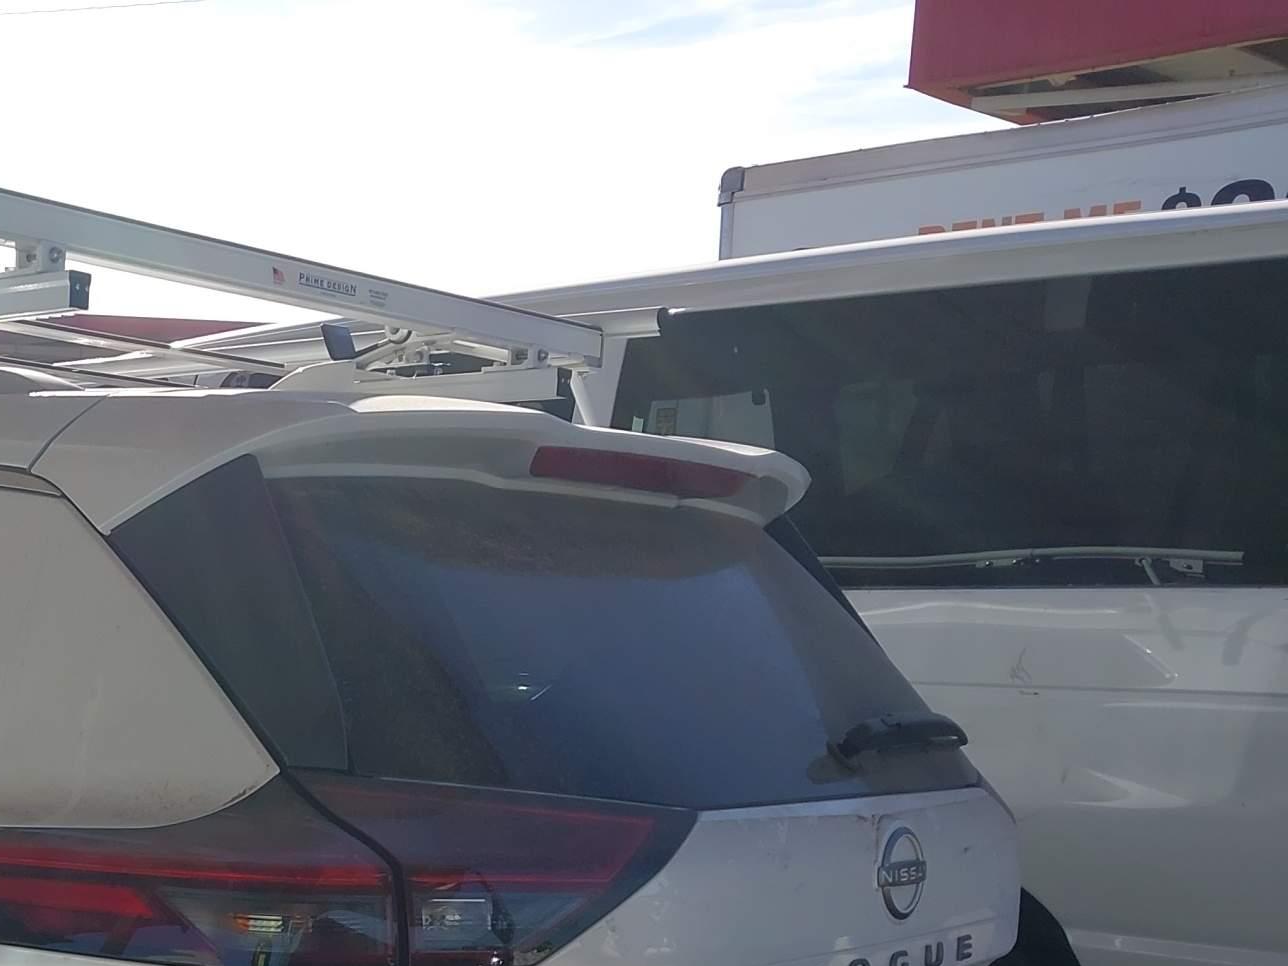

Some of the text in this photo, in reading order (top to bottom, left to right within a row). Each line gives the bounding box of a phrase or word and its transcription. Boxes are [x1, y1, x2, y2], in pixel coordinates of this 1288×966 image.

[298, 271, 325, 288] PRIME
[326, 280, 358, 295] DESIGN
[881, 866, 924, 883] NISS
